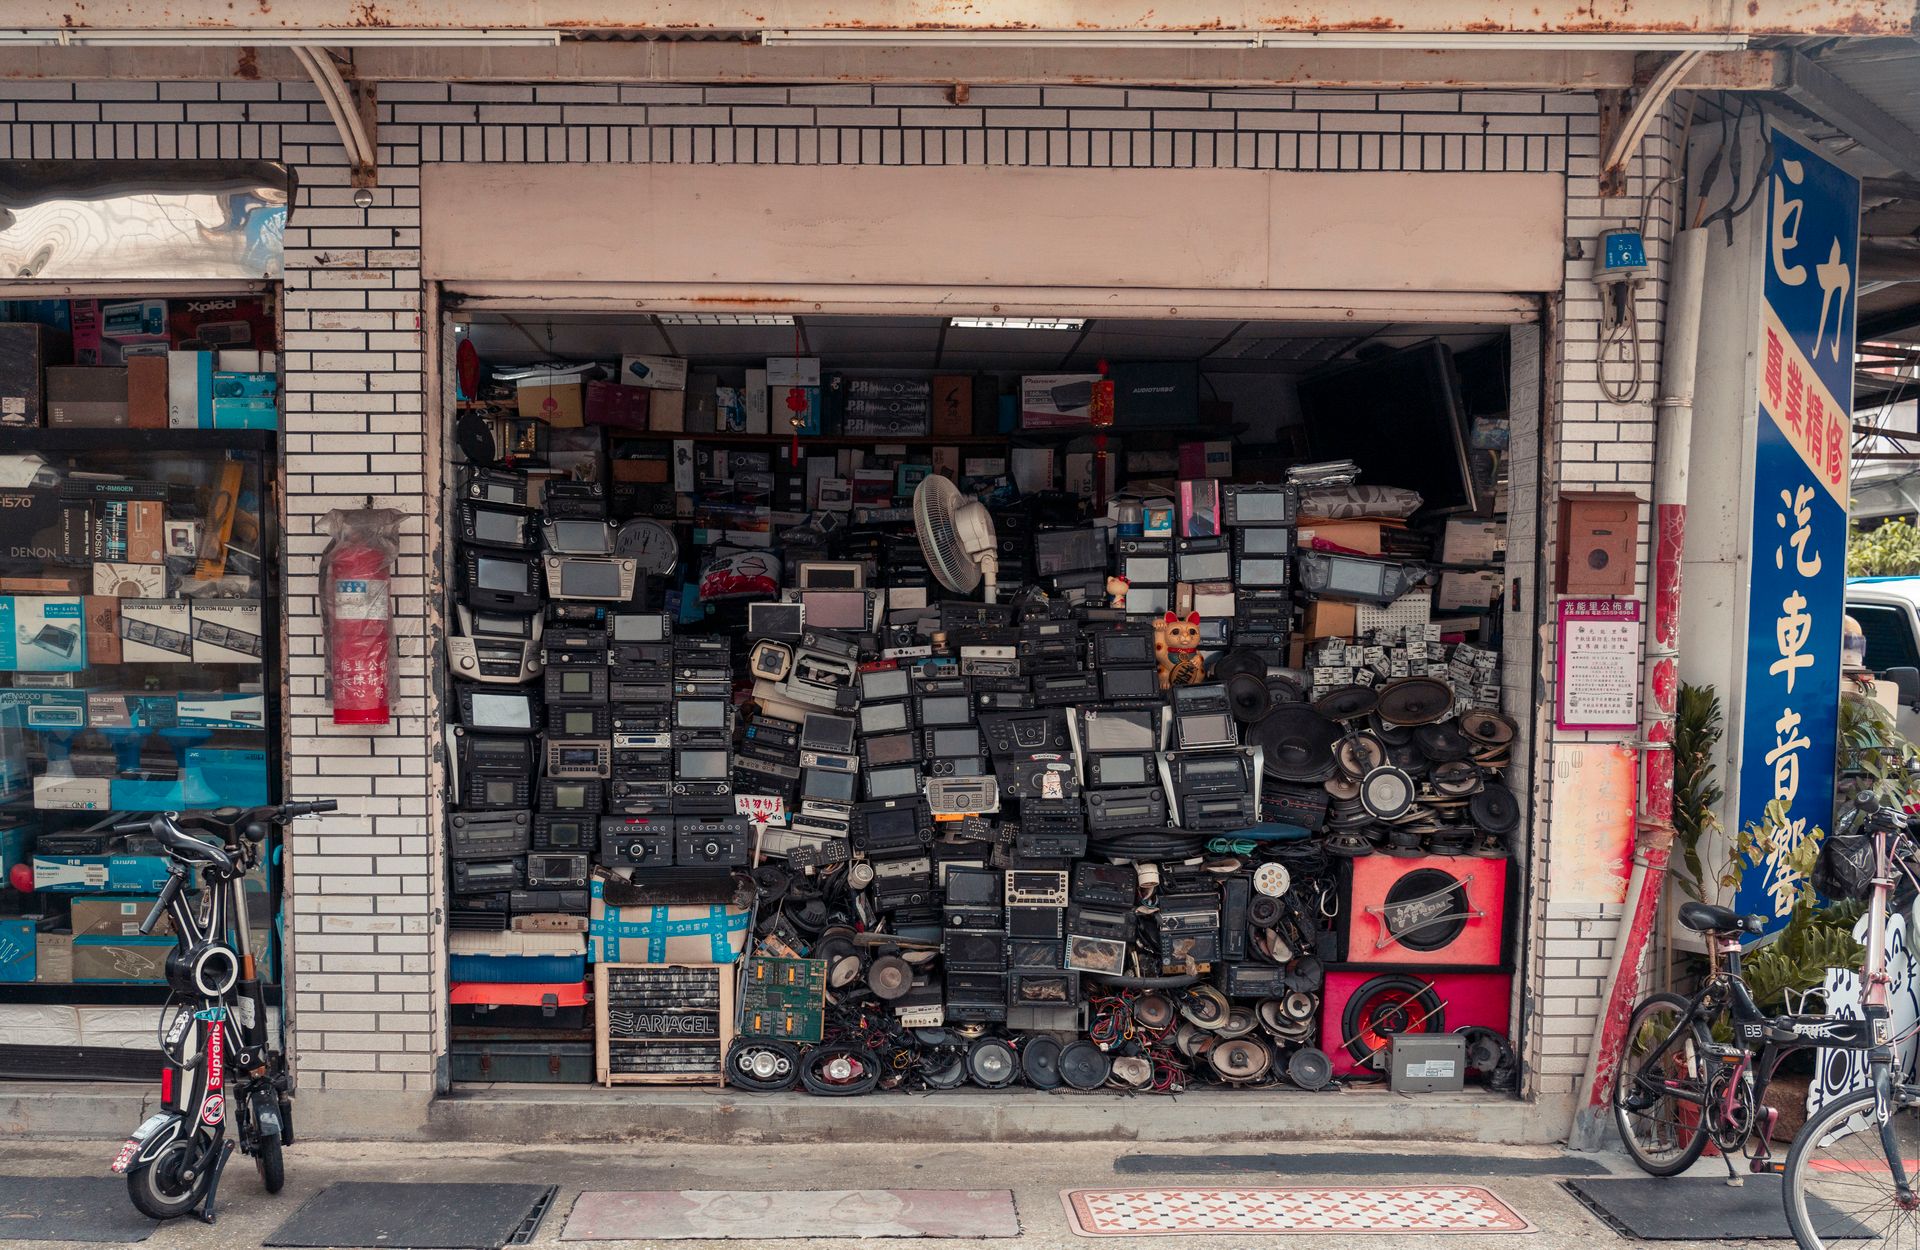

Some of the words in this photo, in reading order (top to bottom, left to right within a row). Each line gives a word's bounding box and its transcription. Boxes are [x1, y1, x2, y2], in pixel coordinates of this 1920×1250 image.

[1765, 326, 1844, 486] 專業精修
[95, 518, 103, 558] WISONIK
[10, 547, 57, 558] DENON
[1, 692, 41, 700] KENWOOD
[1763, 484, 1821, 918] 汽車音響
[739, 797, 782, 812] 請勿動手
[636, 1014, 715, 1034] ARIAGEL
[1743, 1024, 1763, 1038] B5
[210, 1023, 221, 1086] Supreme
